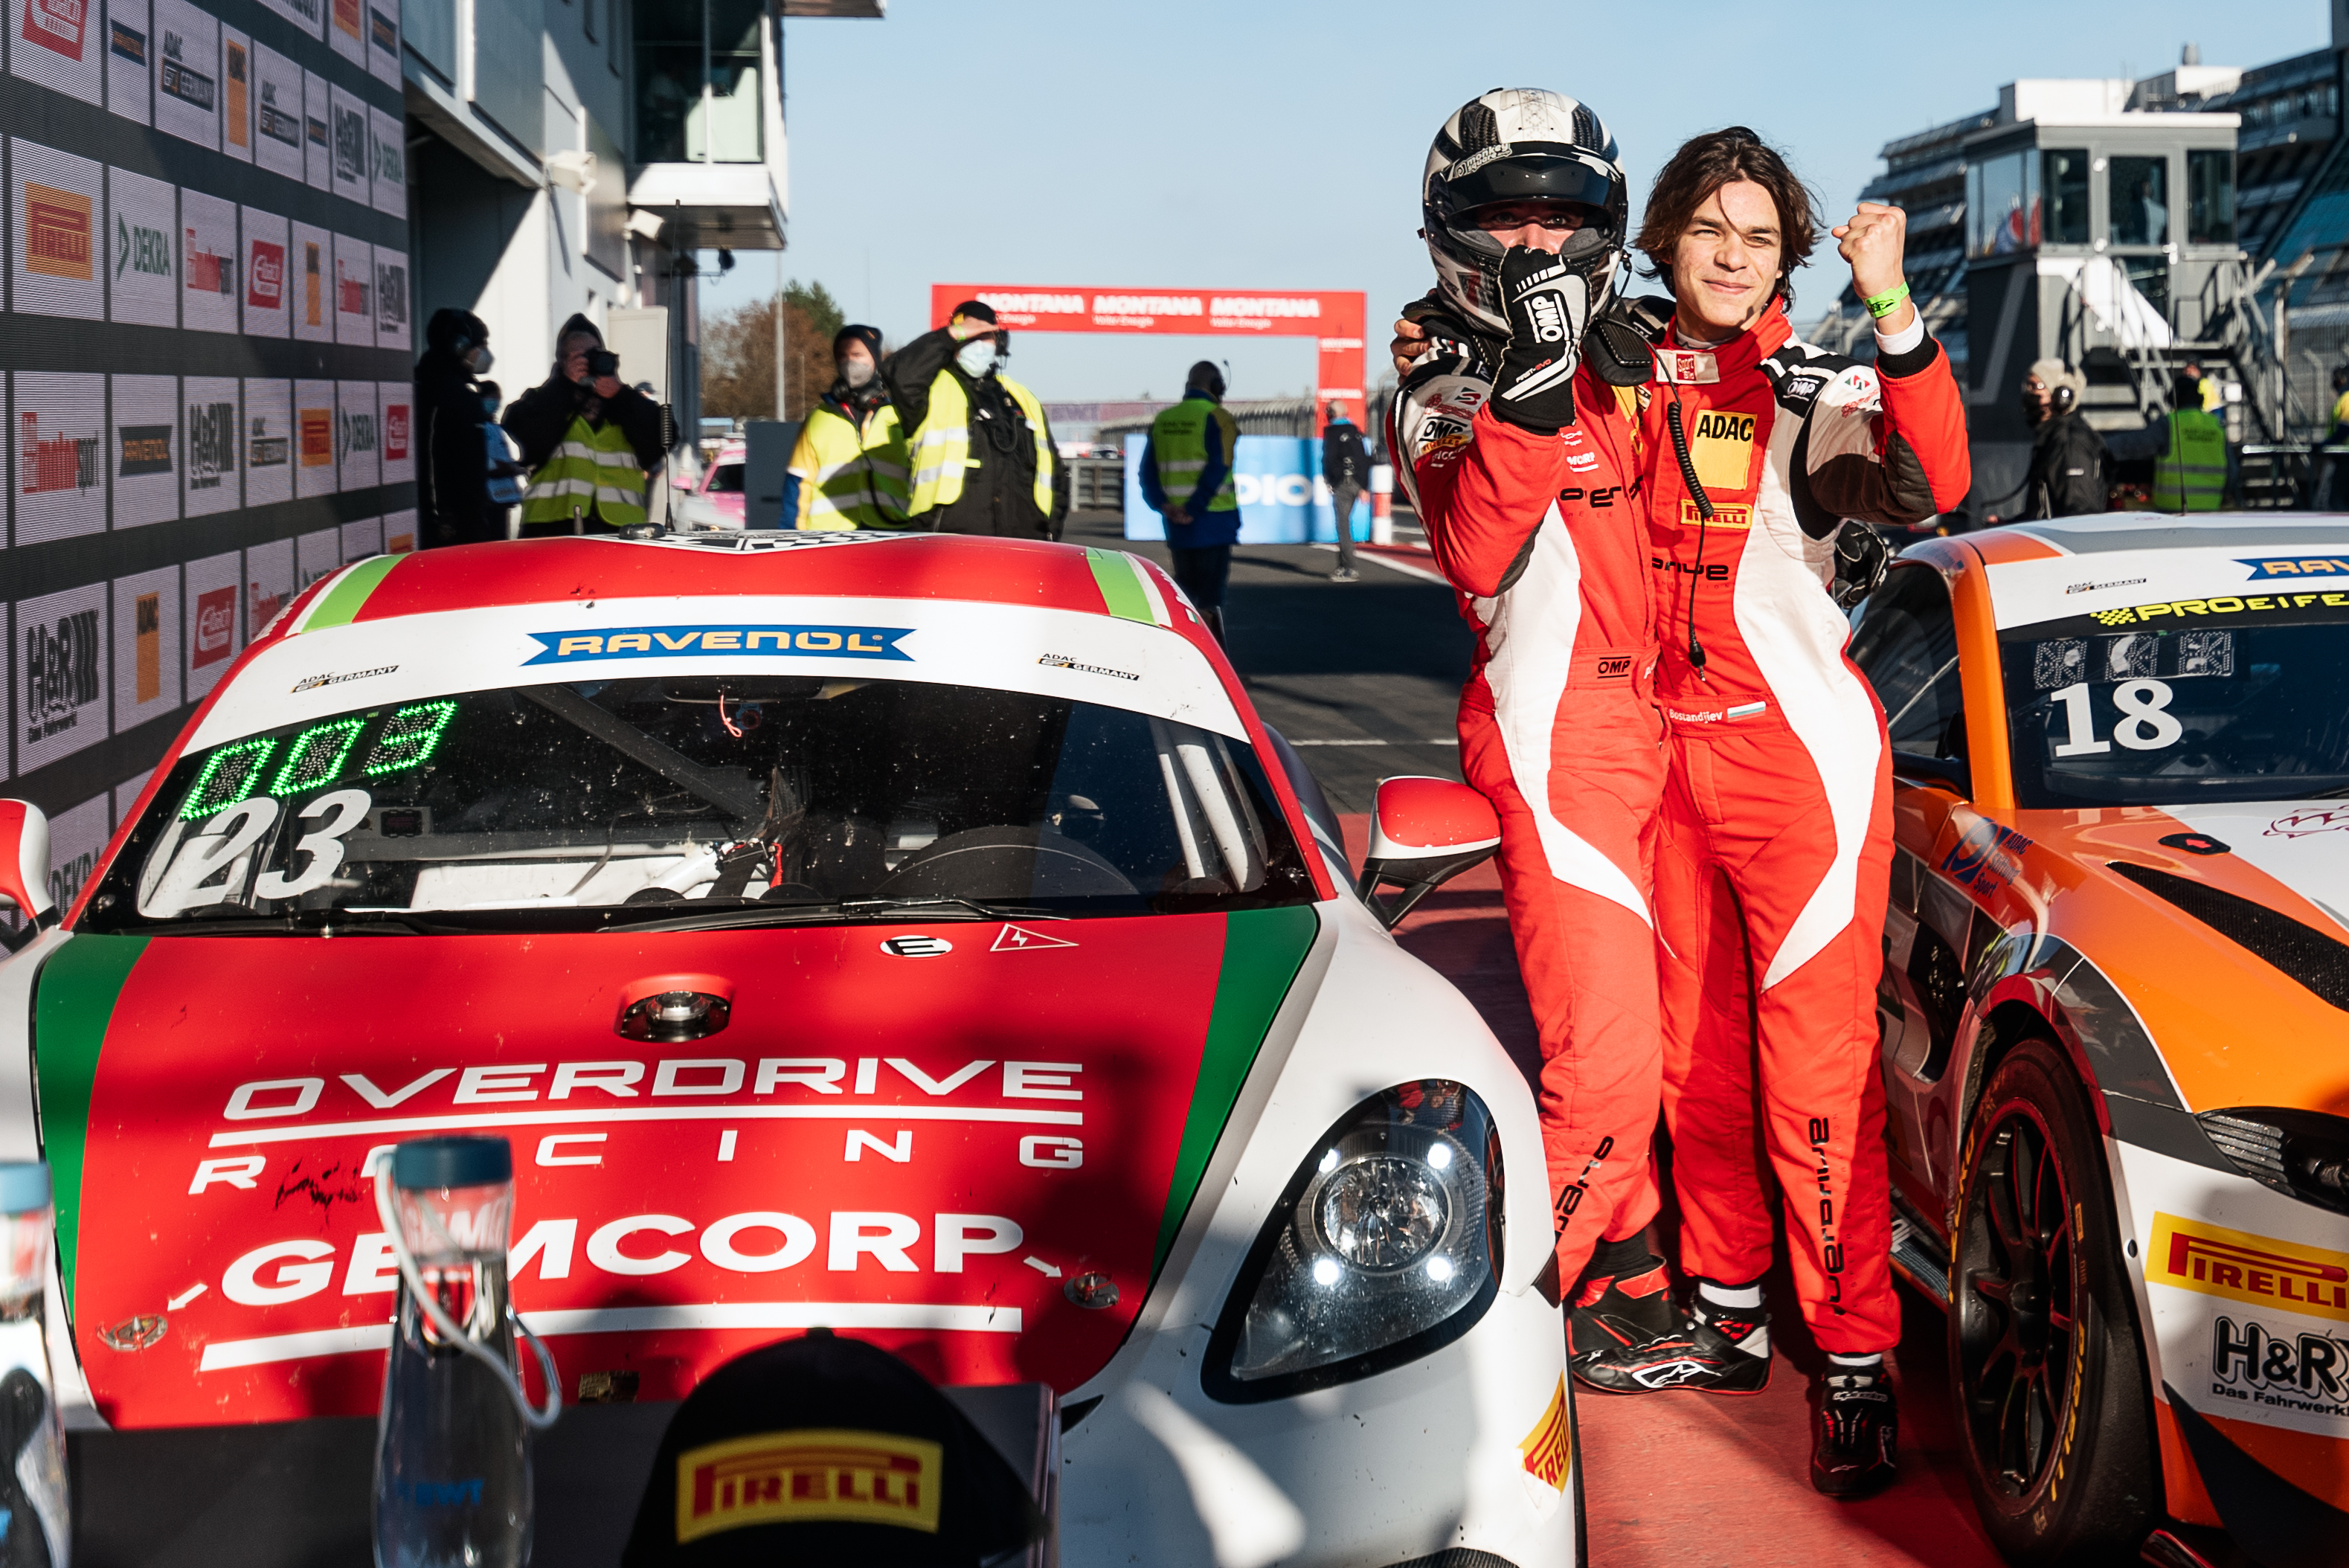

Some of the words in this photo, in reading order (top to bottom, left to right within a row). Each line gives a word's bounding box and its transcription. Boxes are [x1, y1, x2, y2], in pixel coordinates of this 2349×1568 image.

[31, 201, 87, 264] PIRELLI
[133, 225, 171, 277] DEKRA
[976, 293, 1085, 315] MONTANA
[1093, 295, 1203, 316] MONTANA
[1210, 297, 1320, 318] MONTANA
[1531, 295, 1563, 342] OMP
[1787, 380, 1816, 396] OMP
[1697, 414, 1754, 442] ADAC
[1043, 653, 1078, 663] ADAC
[1073, 663, 1137, 680] GERMANY
[1598, 659, 1631, 674] OMP
[299, 671, 335, 684] ADAC
[328, 666, 396, 685] GERMANY
[2051, 678, 2183, 757] 18
[138, 788, 372, 919] 23
[2005, 832, 2034, 855] ADAC
[1973, 872, 1999, 899] Sport
[222, 1056, 1084, 1121] OVERDRIVE
[221, 1210, 1024, 1307] GEMCORP
[2168, 1231, 2349, 1311] PIRELLI
[2214, 1315, 2348, 1404] H&R
[2213, 1382, 2248, 1401] Das
[692, 1443, 924, 1522] PIRELLI
